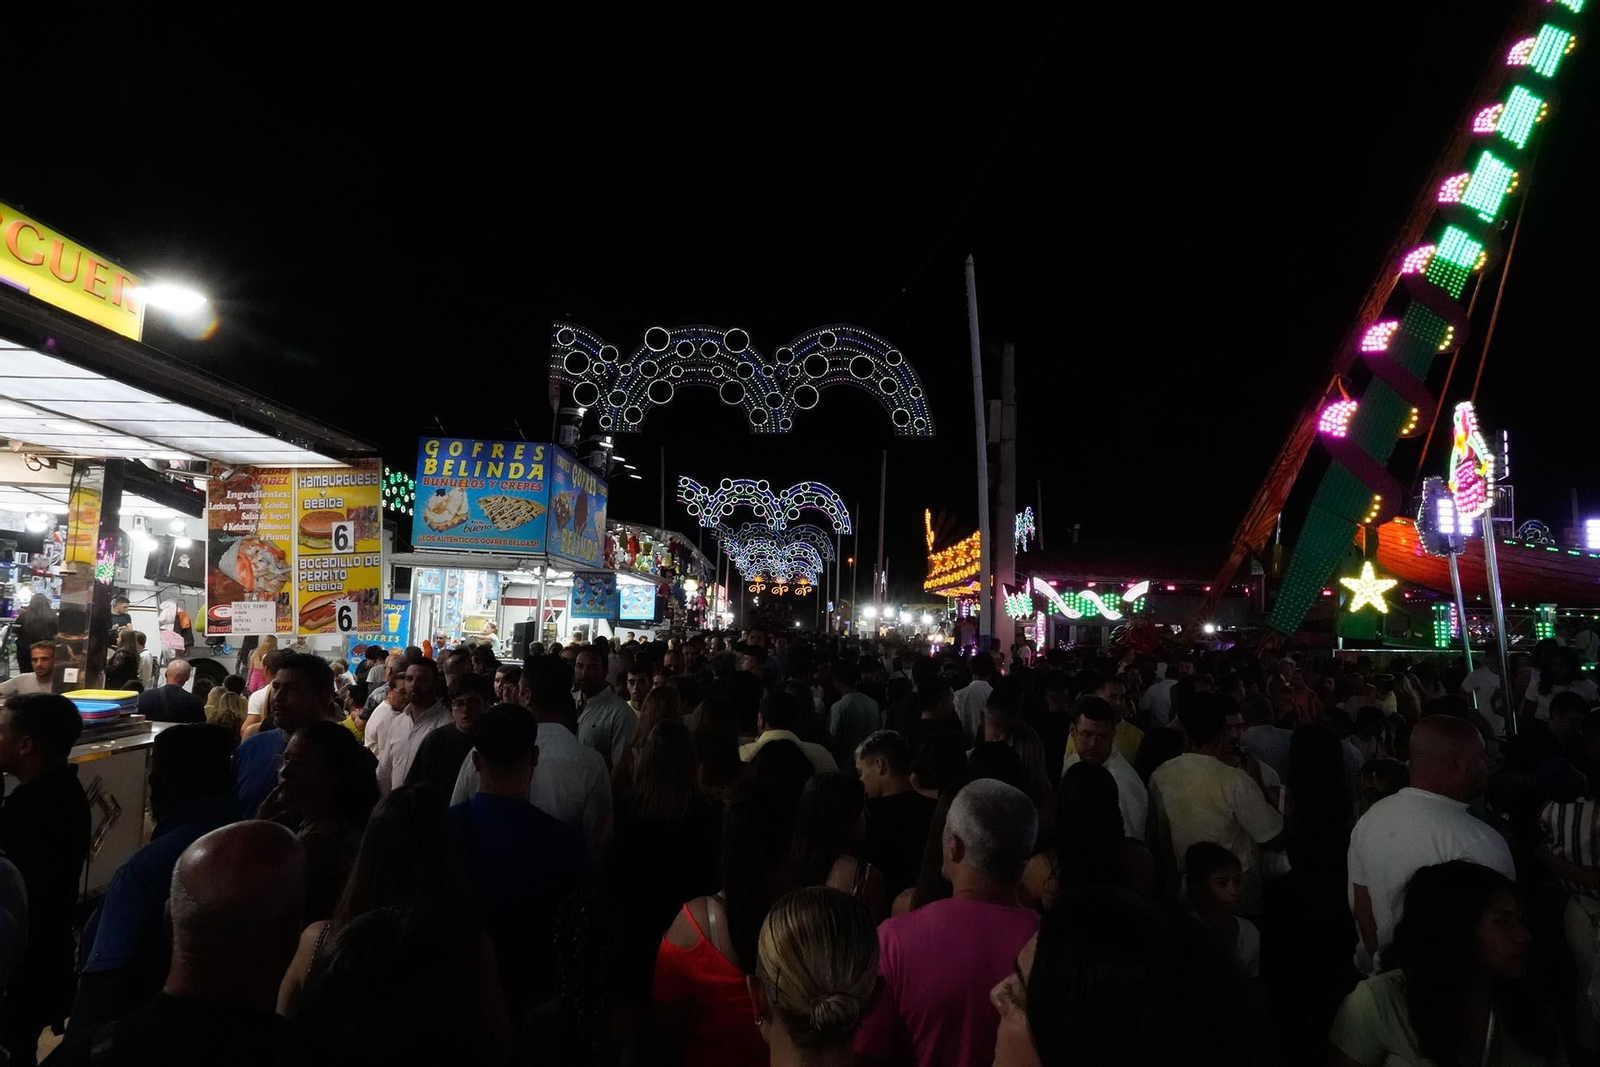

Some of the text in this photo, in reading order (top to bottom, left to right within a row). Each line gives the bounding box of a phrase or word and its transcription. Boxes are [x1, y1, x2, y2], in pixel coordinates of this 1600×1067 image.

[0, 212, 137, 315] GUER
[424, 440, 545, 460] GOFRES
[423, 458, 544, 480] BELINDA
[572, 463, 597, 497] GOFRES
[226, 490, 291, 500] Ingredientes:
[208, 502, 237, 511] Lechuga,
[238, 502, 263, 510] Tomate,
[241, 512, 259, 520] Salsa
[269, 512, 290, 520] Yogurt
[228, 522, 256, 532] Ketchup,
[258, 522, 290, 530] Mahonesa
[463, 524, 492, 533] bueno
[480, 537, 508, 546] GOFRES
[561, 527, 598, 561] BELINDA
[299, 570, 347, 581] PERRITO
[384, 603, 406, 611] ADOS
[357, 634, 400, 642] GOFRES
